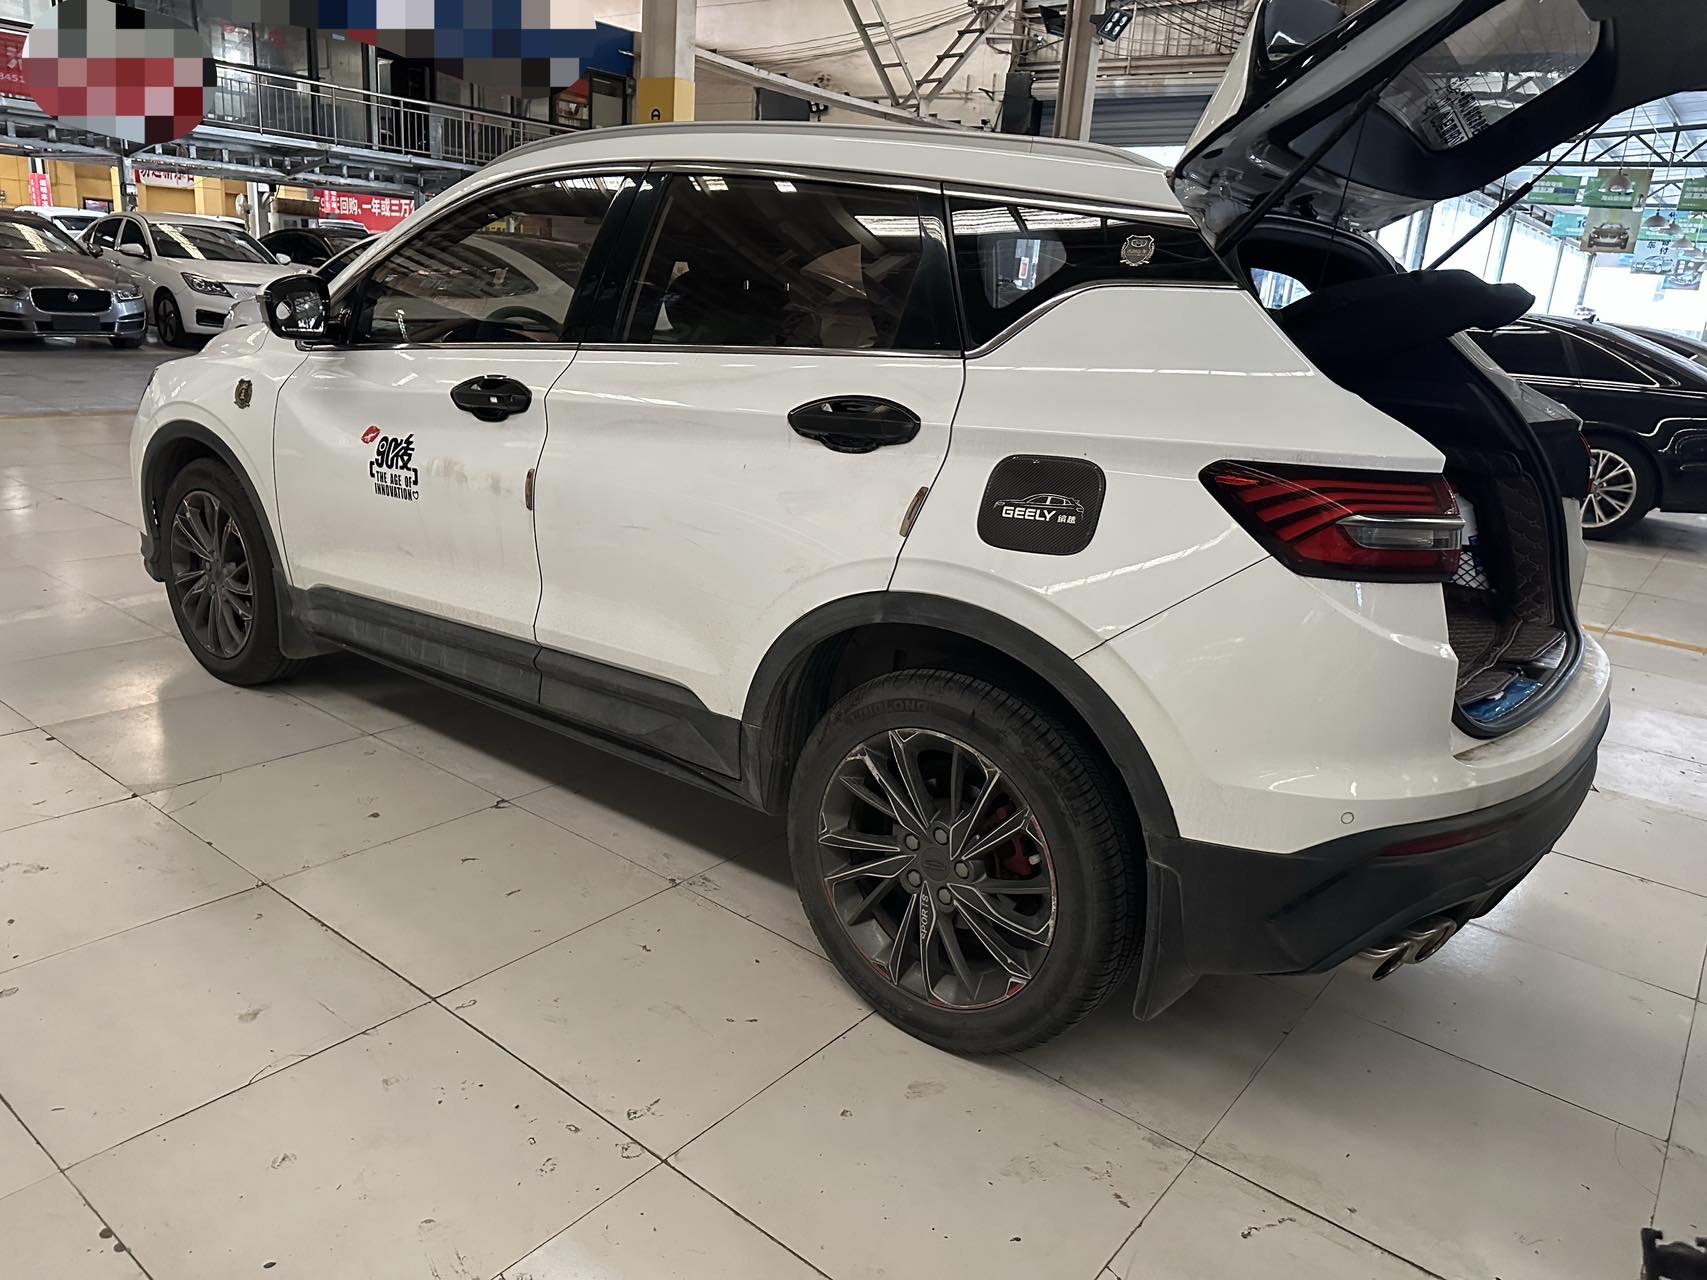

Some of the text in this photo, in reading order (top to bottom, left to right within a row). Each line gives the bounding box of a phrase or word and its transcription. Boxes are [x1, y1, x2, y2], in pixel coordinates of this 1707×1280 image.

[375, 470, 412, 488] THE AGE OF
[374, 482, 413, 501] INNOVATION
[1001, 505, 1057, 522] GEELY
